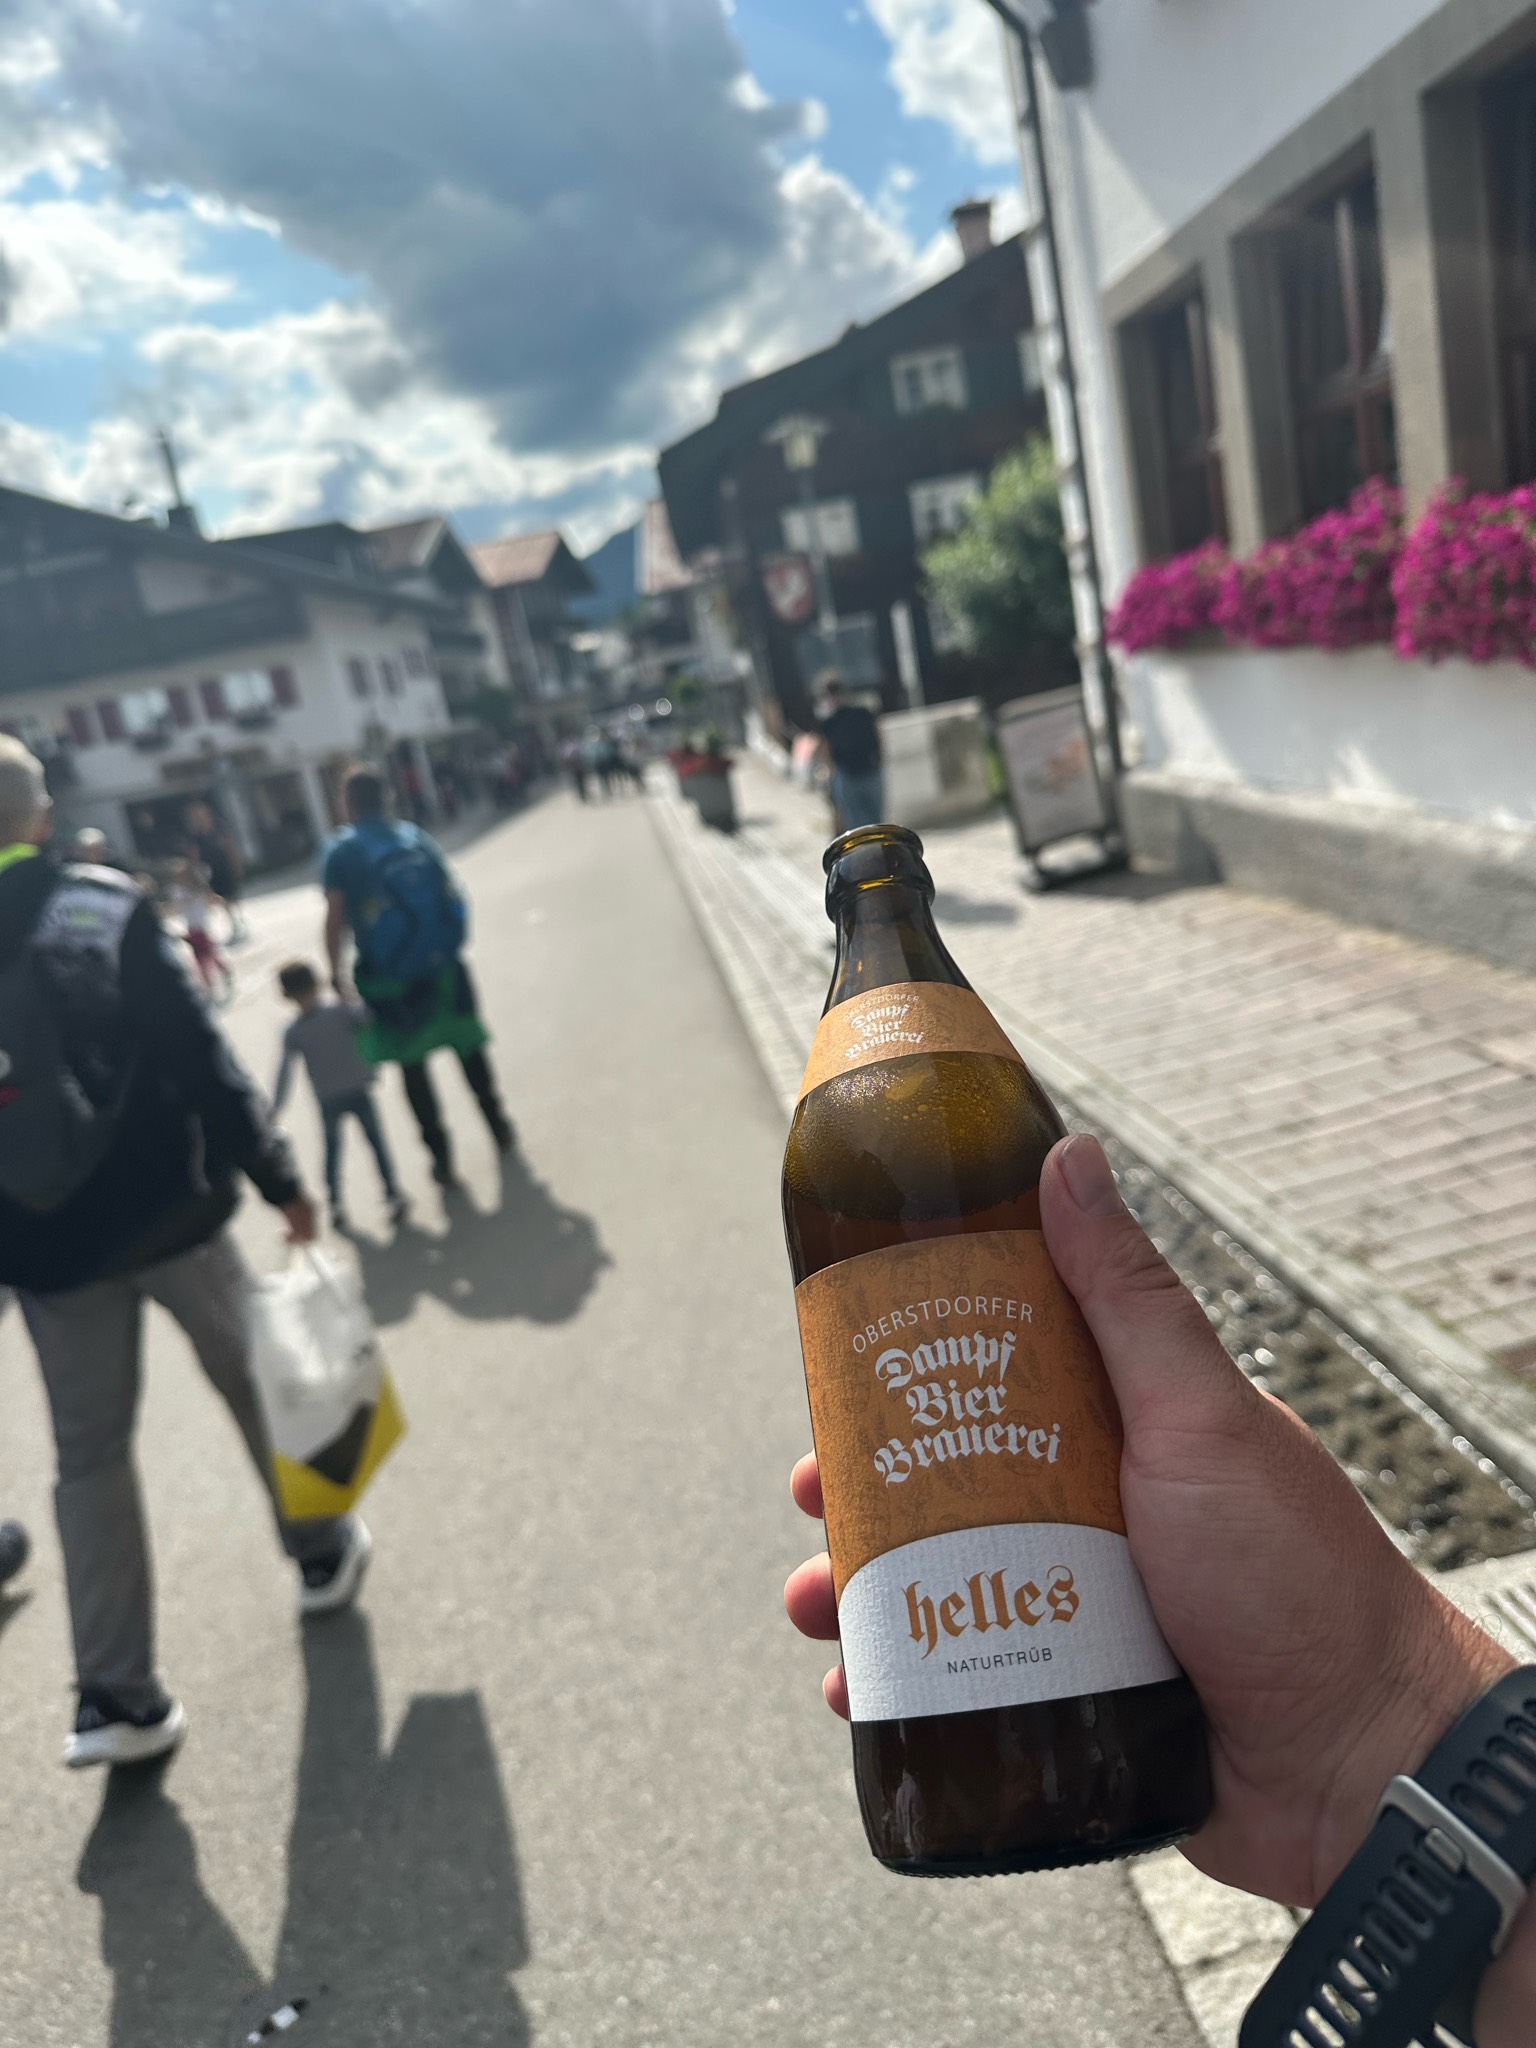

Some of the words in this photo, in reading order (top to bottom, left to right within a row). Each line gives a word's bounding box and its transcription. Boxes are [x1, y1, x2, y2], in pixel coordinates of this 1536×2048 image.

[850, 1003, 910, 1030] Dampf
[861, 1019, 903, 1038] Bier
[844, 1031, 925, 1058] Brauerei
[852, 1295, 1034, 1353] OBERSTDORFER
[875, 1330, 1017, 1394] Dampf
[905, 1379, 1008, 1426] Bier
[873, 1422, 1061, 1488] Brauerei
[901, 1565, 1080, 1660] helles
[947, 1646, 1053, 1674] NATURTRÜB
